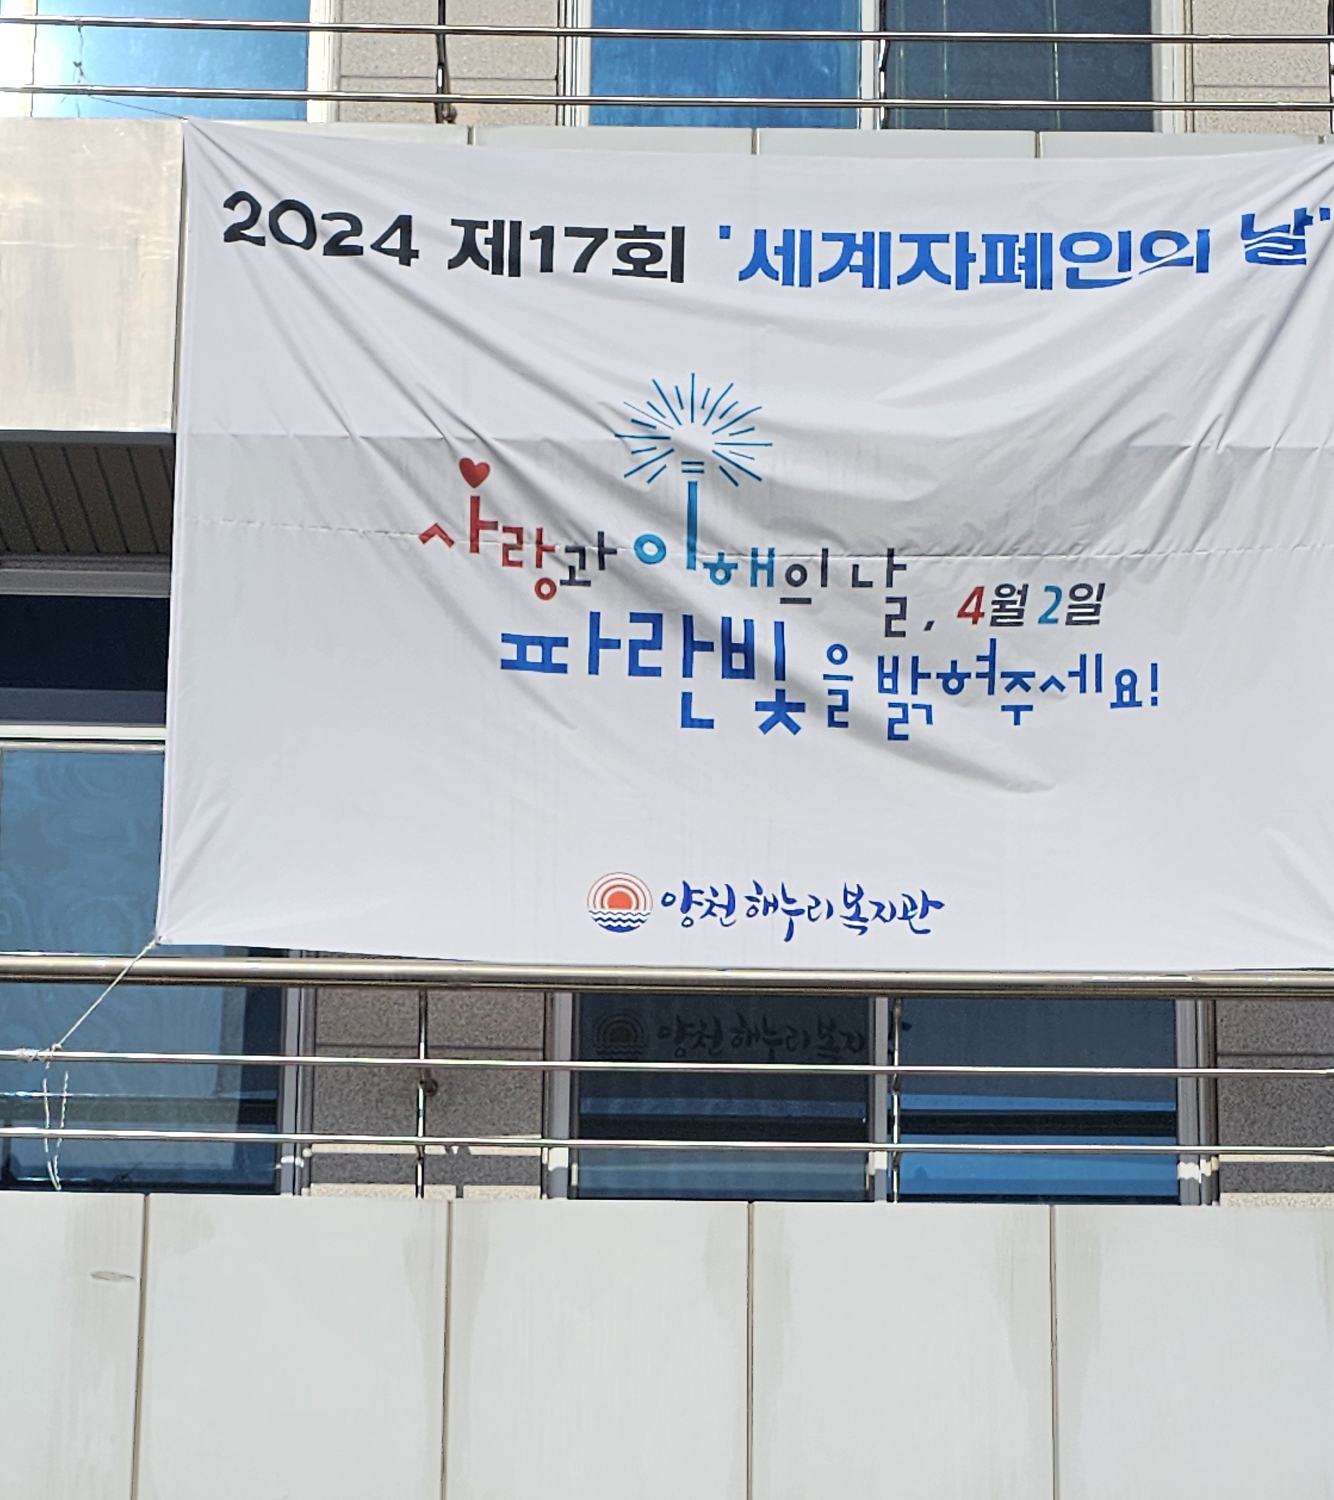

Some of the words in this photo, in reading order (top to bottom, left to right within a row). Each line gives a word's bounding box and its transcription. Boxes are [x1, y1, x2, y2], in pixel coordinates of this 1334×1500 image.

[224, 190, 420, 267] 2024
[448, 218, 686, 284] 제17회
[719, 225, 1211, 291] '세계자폐인의
[1241, 207, 1331, 266] 날'
[419, 496, 617, 601] 사랑과
[633, 480, 829, 605] 이해의
[851, 547, 935, 638] 날,
[957, 584, 1029, 627] 4월
[1037, 582, 1106, 626] 2일
[877, 637, 1158, 741] 밝혀주세요!
